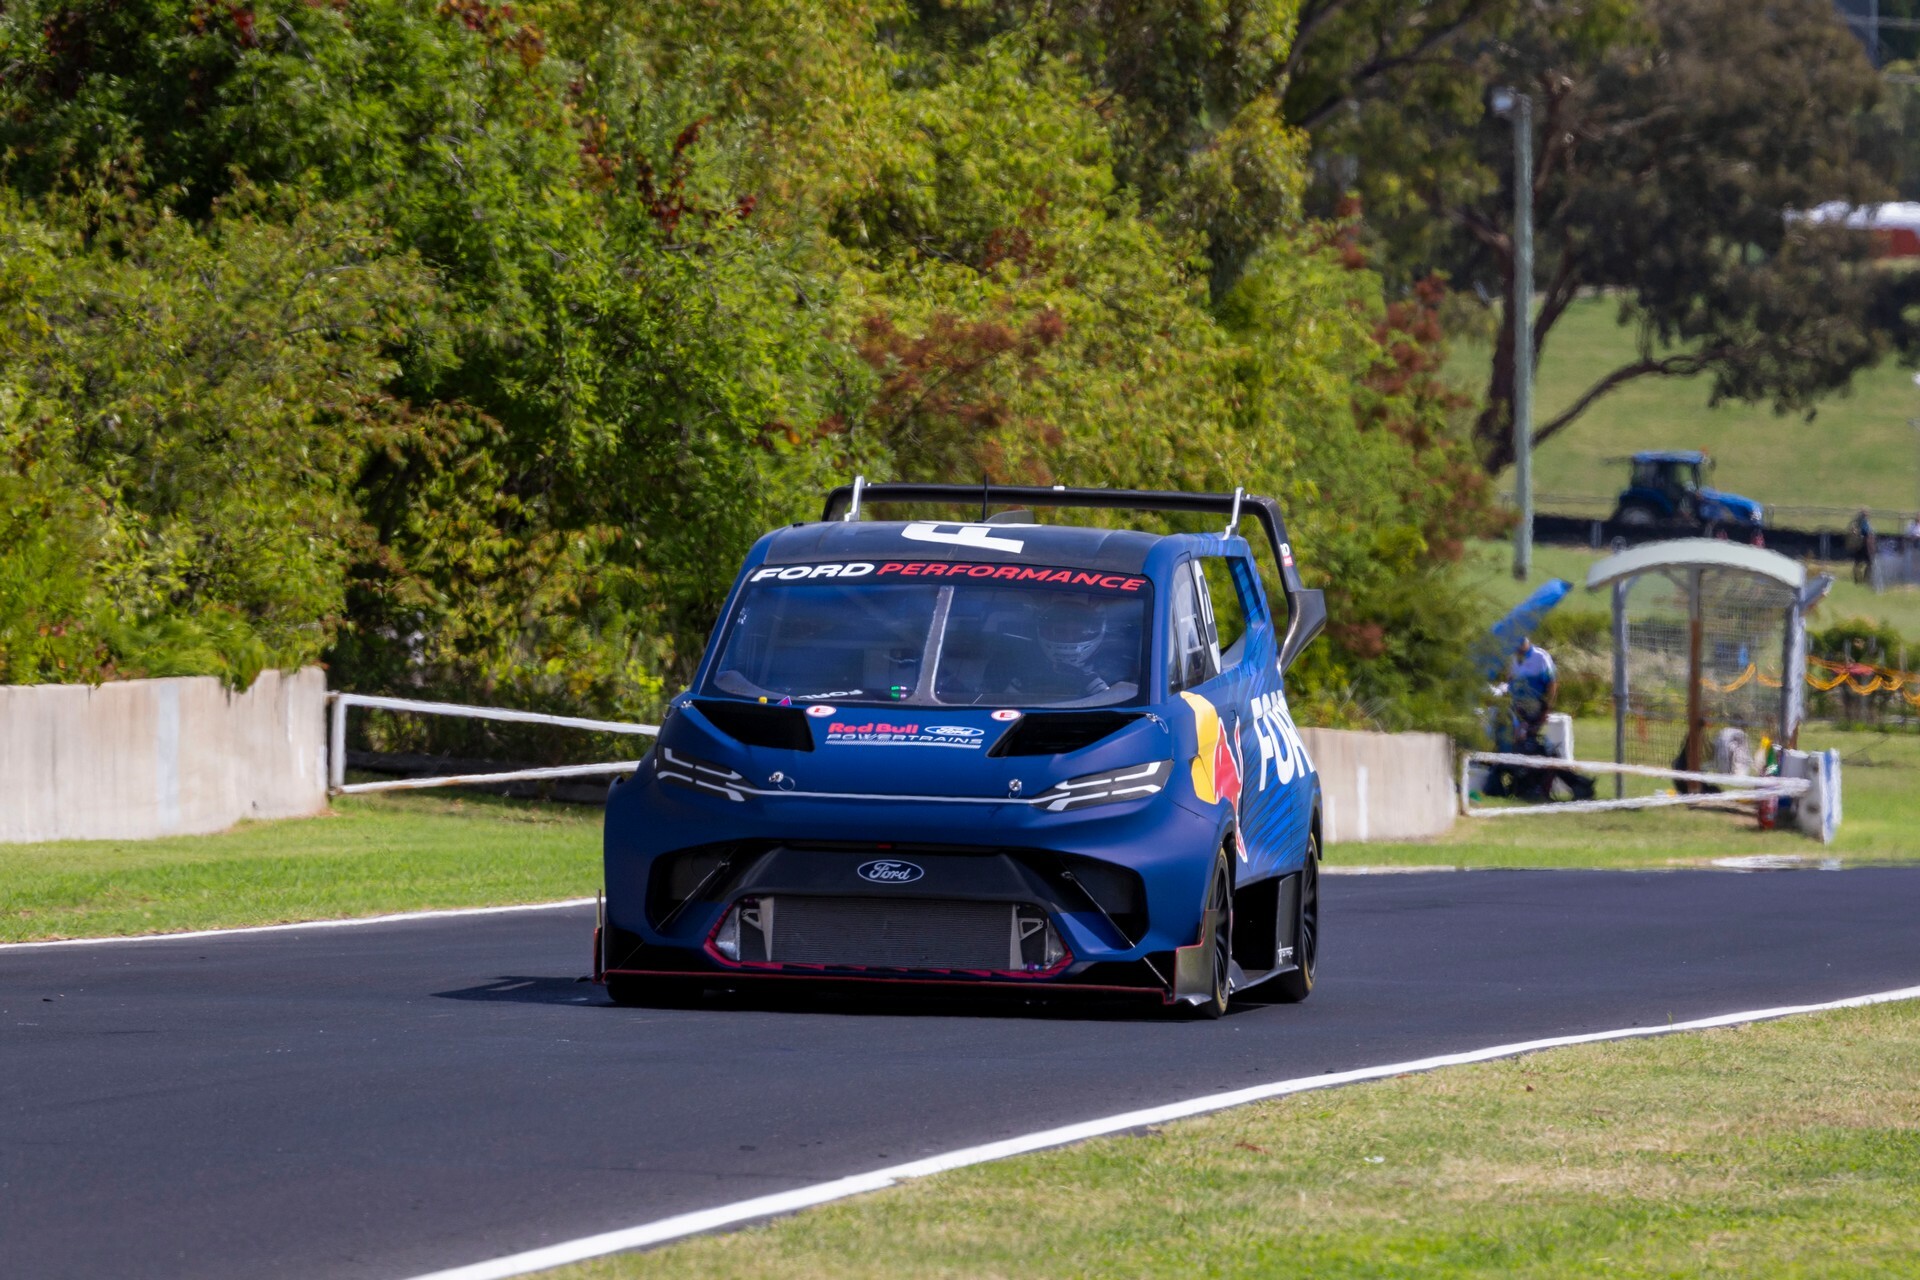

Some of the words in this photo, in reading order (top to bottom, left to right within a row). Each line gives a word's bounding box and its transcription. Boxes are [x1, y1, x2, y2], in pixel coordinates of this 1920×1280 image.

[750, 562, 875, 582] FORD
[877, 562, 1147, 591] PERFORMANCE
[828, 722, 874, 734] Red
[875, 723, 919, 734] Bull
[826, 733, 984, 745] POWERTRAINS
[1250, 689, 1316, 792] FOR
[866, 861, 914, 881] Ford
